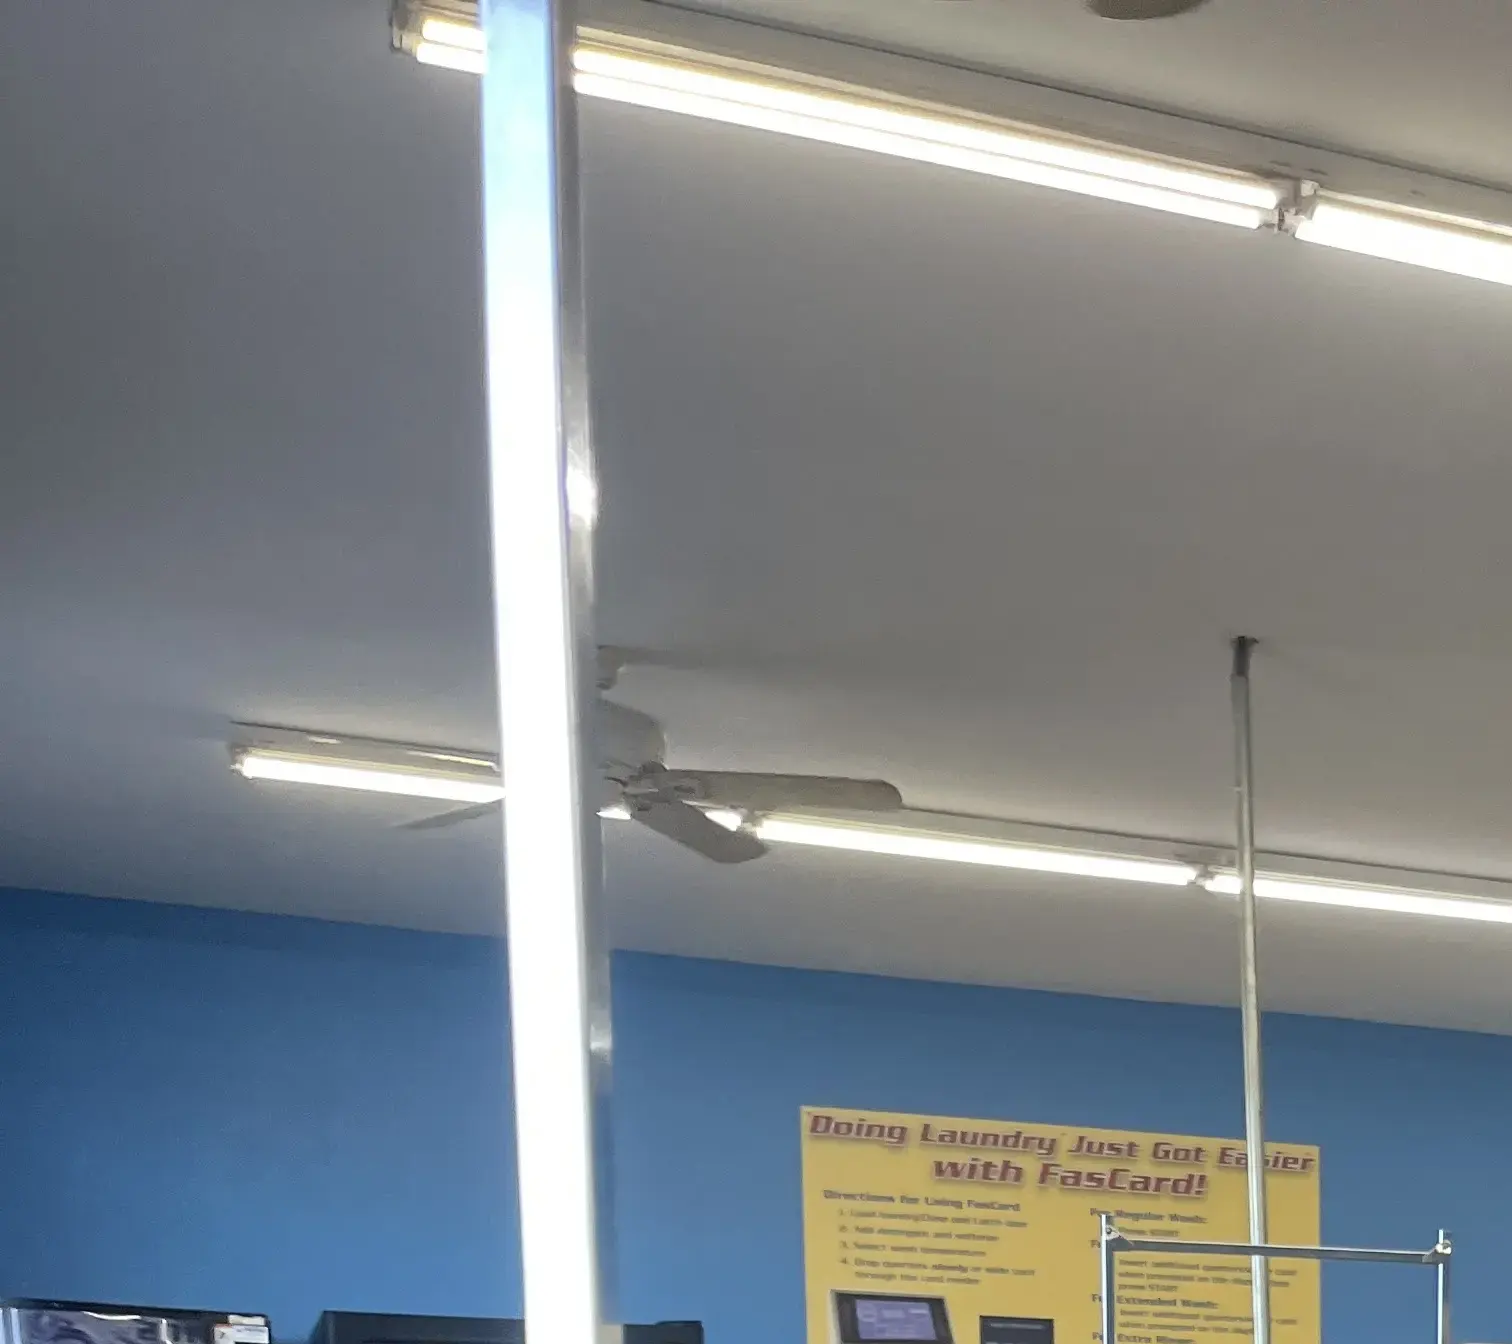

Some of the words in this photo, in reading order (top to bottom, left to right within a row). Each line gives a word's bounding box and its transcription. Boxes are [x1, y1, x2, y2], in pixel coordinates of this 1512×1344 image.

[809, 1115, 908, 1144] Doing
[920, 1123, 1057, 1156] Laundry
[1067, 1135, 1140, 1158] Just
[1152, 1142, 1207, 1163] Got
[1217, 1147, 1316, 1171] Eaier
[933, 1158, 1023, 1182] with
[1039, 1163, 1208, 1196] FasCard!
